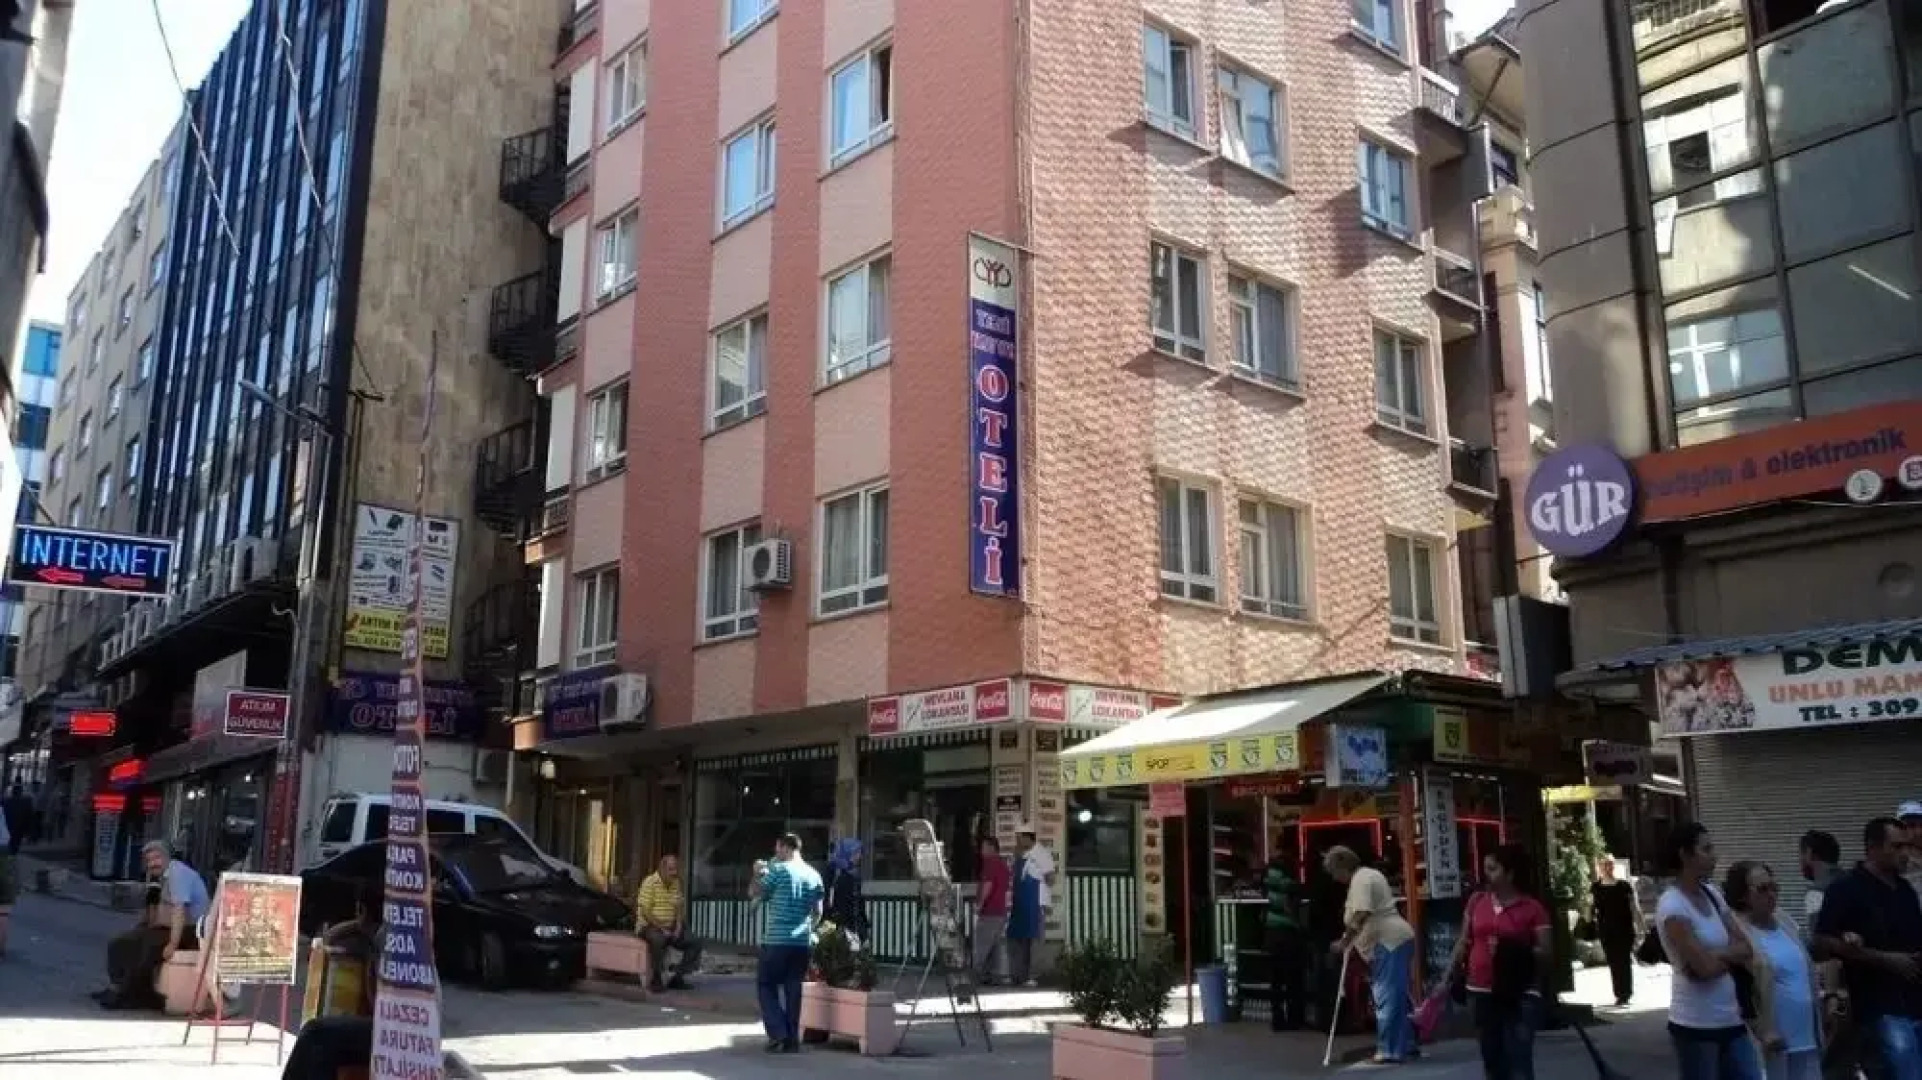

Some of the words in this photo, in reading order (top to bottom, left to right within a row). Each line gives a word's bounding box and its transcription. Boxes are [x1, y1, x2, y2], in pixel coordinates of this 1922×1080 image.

[978, 365, 1009, 584] OTELİ
[1766, 428, 1907, 475] elektronik
[1531, 463, 1629, 537] GÜR
[1799, 704, 1842, 722] TEL
[1867, 696, 1919, 717] 309
